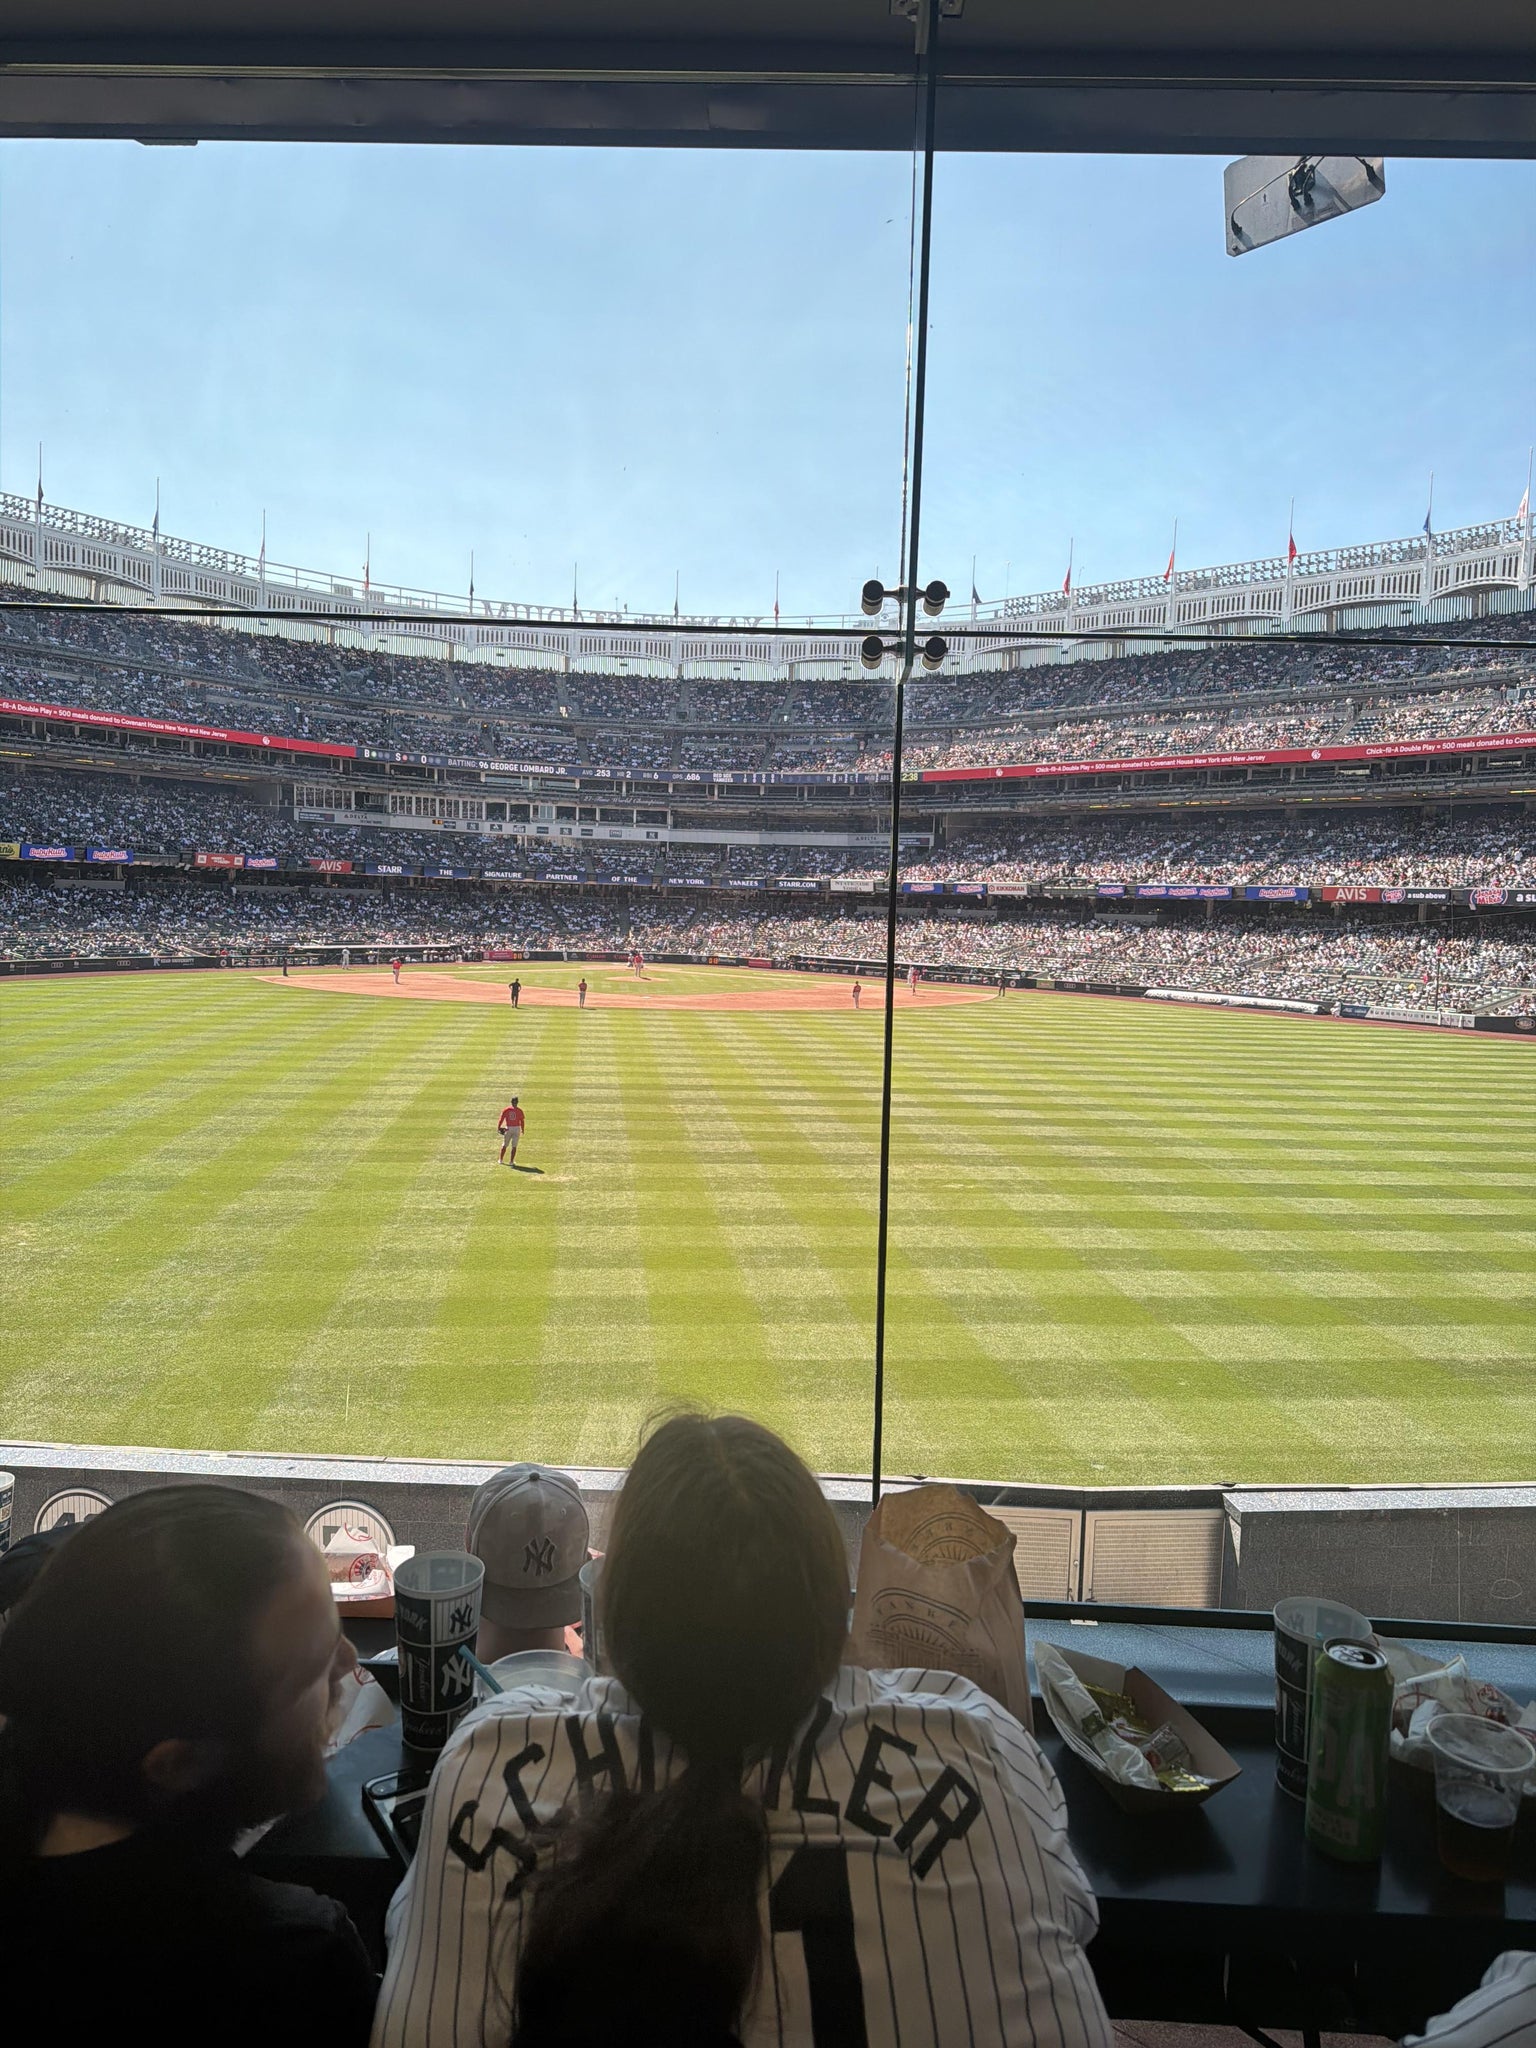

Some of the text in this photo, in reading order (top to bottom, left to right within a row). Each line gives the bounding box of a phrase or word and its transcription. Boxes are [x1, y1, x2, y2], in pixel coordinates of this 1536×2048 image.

[17, 704, 39, 713] Double
[39, 706, 53, 715] Play
[58, 709, 71, 717] 500
[89, 713, 113, 722] donated
[113, 716, 120, 724] to
[121, 718, 148, 727] Covenant
[148, 721, 164, 729] House
[164, 723, 176, 731] New
[189, 726, 199, 734] and
[199, 728, 211, 736] New
[211, 730, 228, 739] Jersey
[1366, 746, 1399, 755] Chick-fil-A
[1399, 744, 1422, 753] Double
[1422, 744, 1436, 752] Play
[1442, 742, 1456, 750] 500
[1456, 740, 1475, 749] meals
[1476, 738, 1505, 747] donated
[364, 749, 370, 758] B
[395, 752, 401, 761] S
[447, 758, 478, 768] BATTING:
[478, 761, 489, 769] 96
[490, 762, 519, 772] GEORGE
[519, 764, 555, 774] LOMBARD
[555, 767, 568, 775] JR.
[594, 769, 611, 777] .253
[653, 772, 659, 780] 6
[1176, 758, 1194, 766] House
[902, 773, 918, 782] 2:38
[319, 861, 343, 871] AVIS
[377, 864, 402, 874] STARR
[484, 871, 522, 879] SIGNATURE
[546, 873, 578, 881] PARTNER
[1336, 888, 1368, 900] AVIS
[1516, 894, 1524, 902] a
[521, 1536, 557, 1576] NY
[449, 1604, 473, 1634] NY
[440, 1653, 472, 1697] NY
